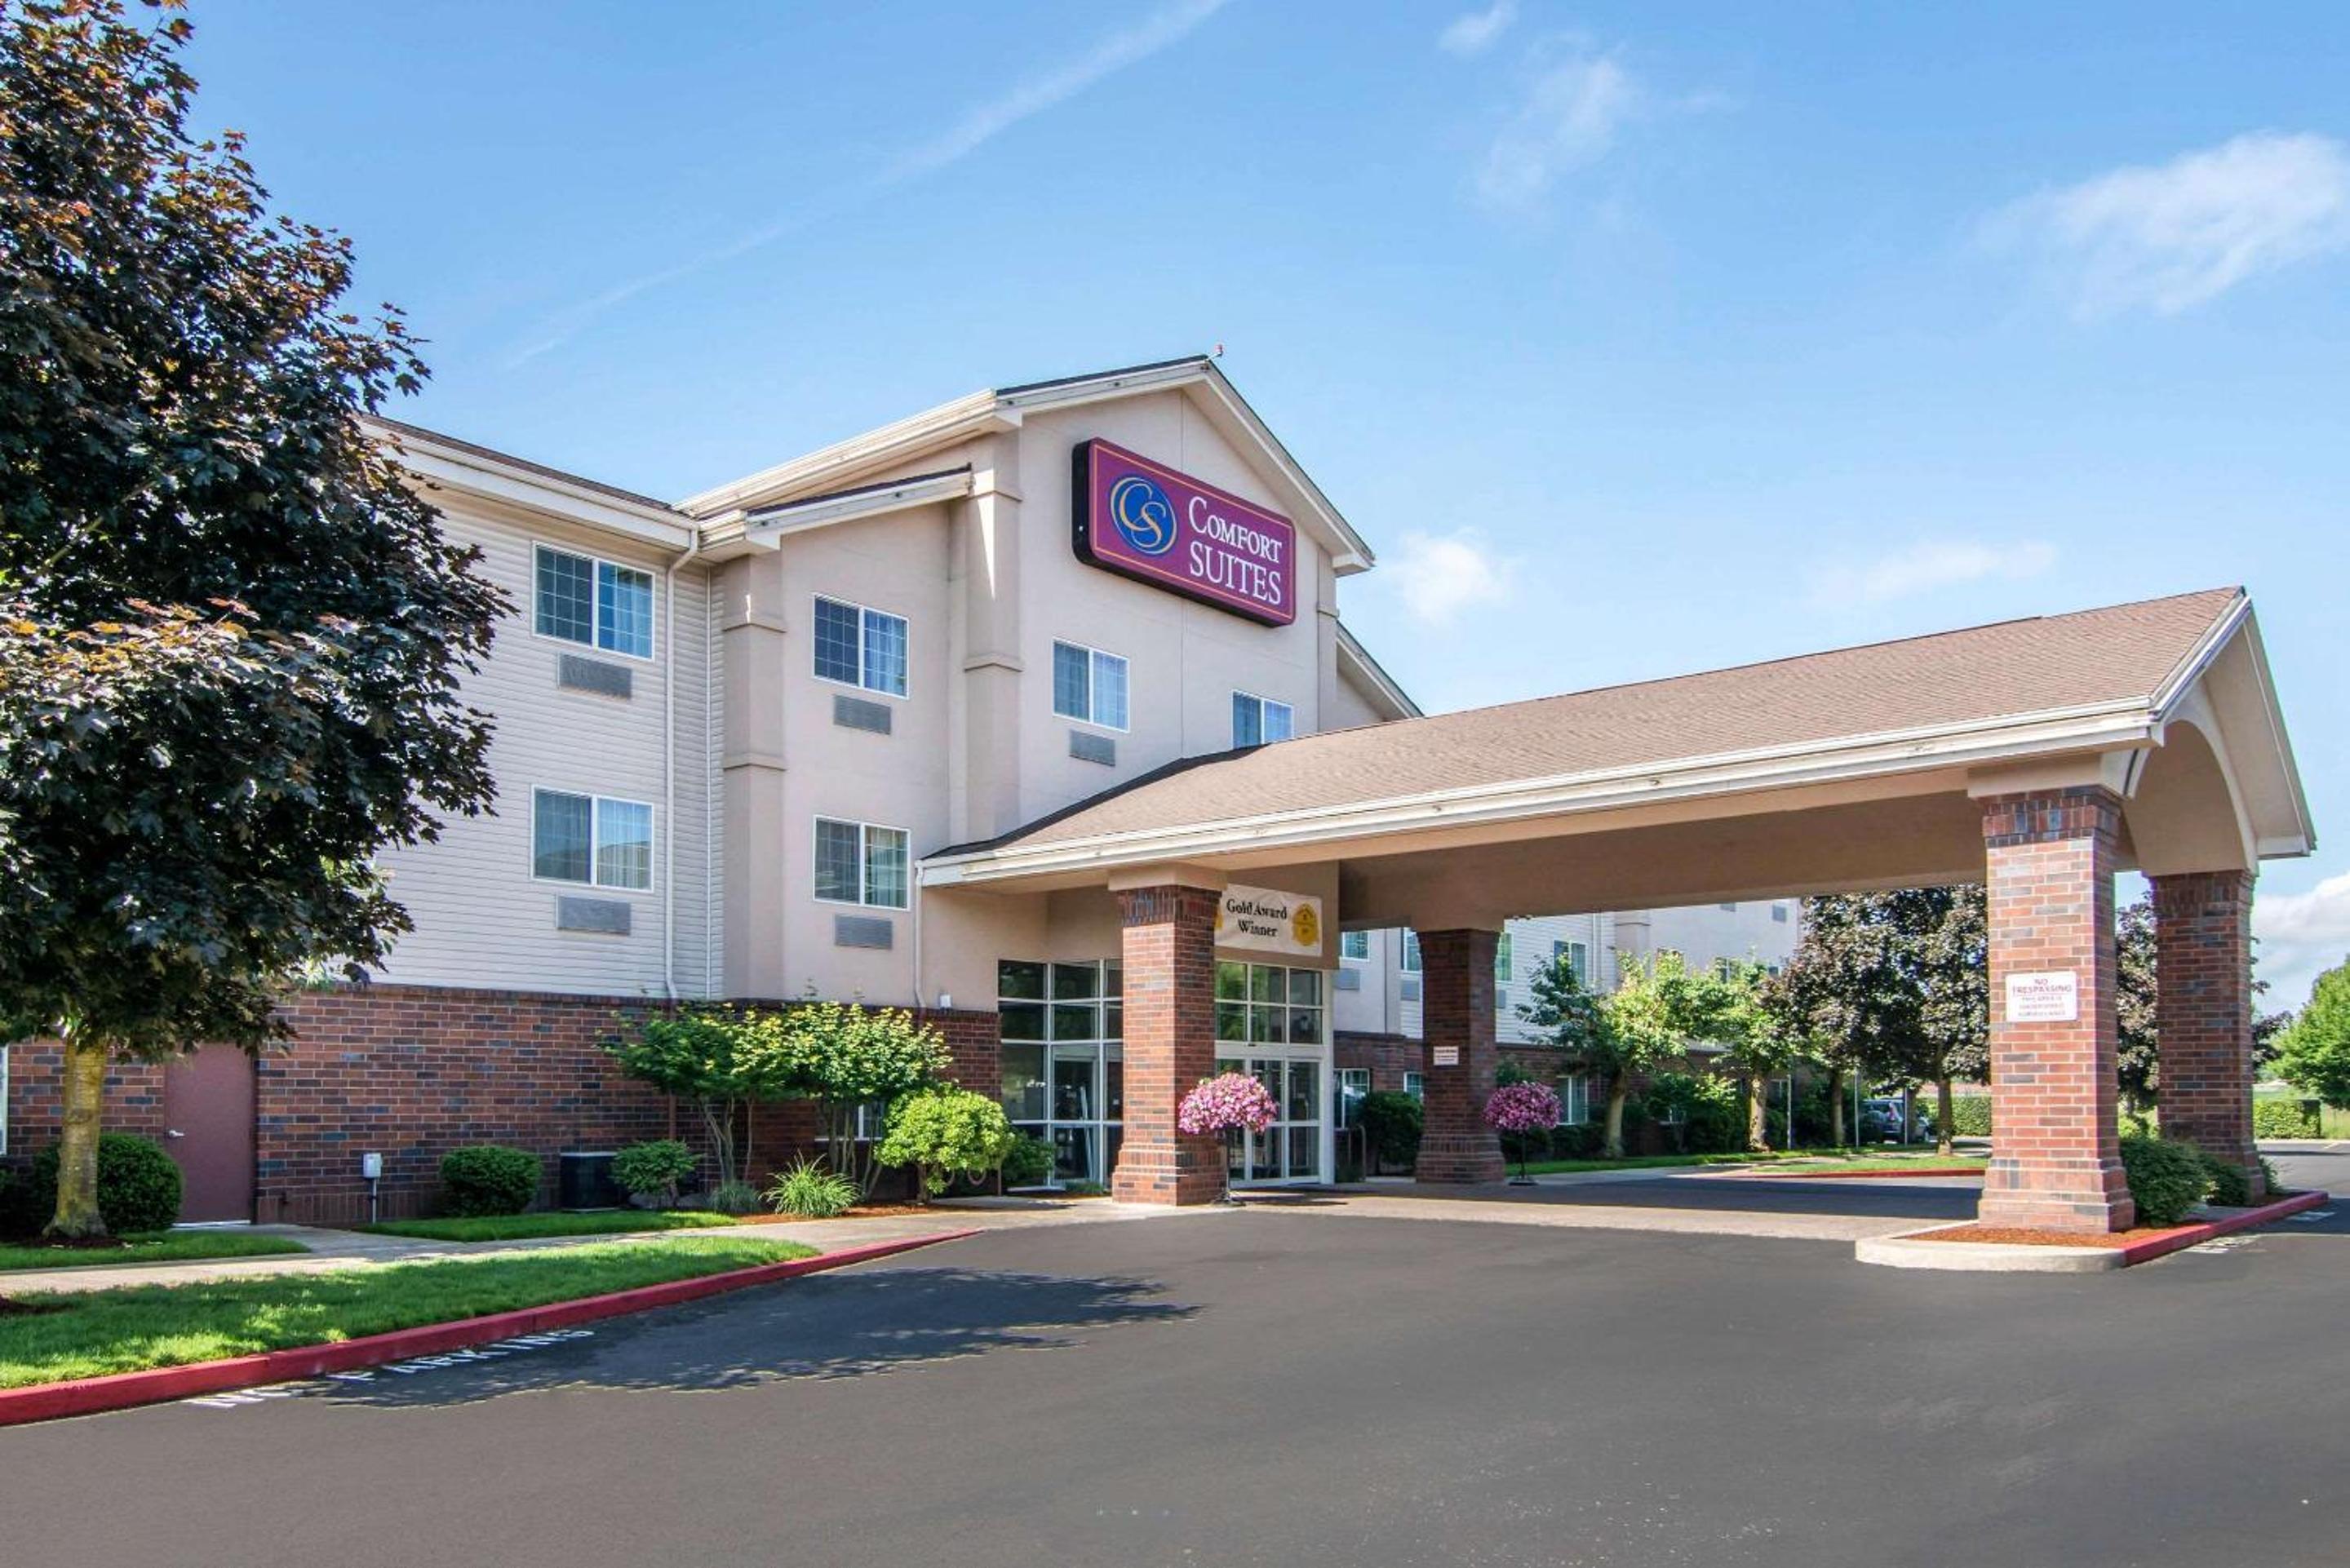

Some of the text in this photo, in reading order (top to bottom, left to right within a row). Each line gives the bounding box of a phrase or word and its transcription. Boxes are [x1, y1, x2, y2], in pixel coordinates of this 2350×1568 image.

[1189, 496, 1282, 563] COMFORT
[1190, 541, 1281, 605] SUITES
[1226, 899, 1288, 919] Gold Award
[1238, 919, 1278, 937] Winner
